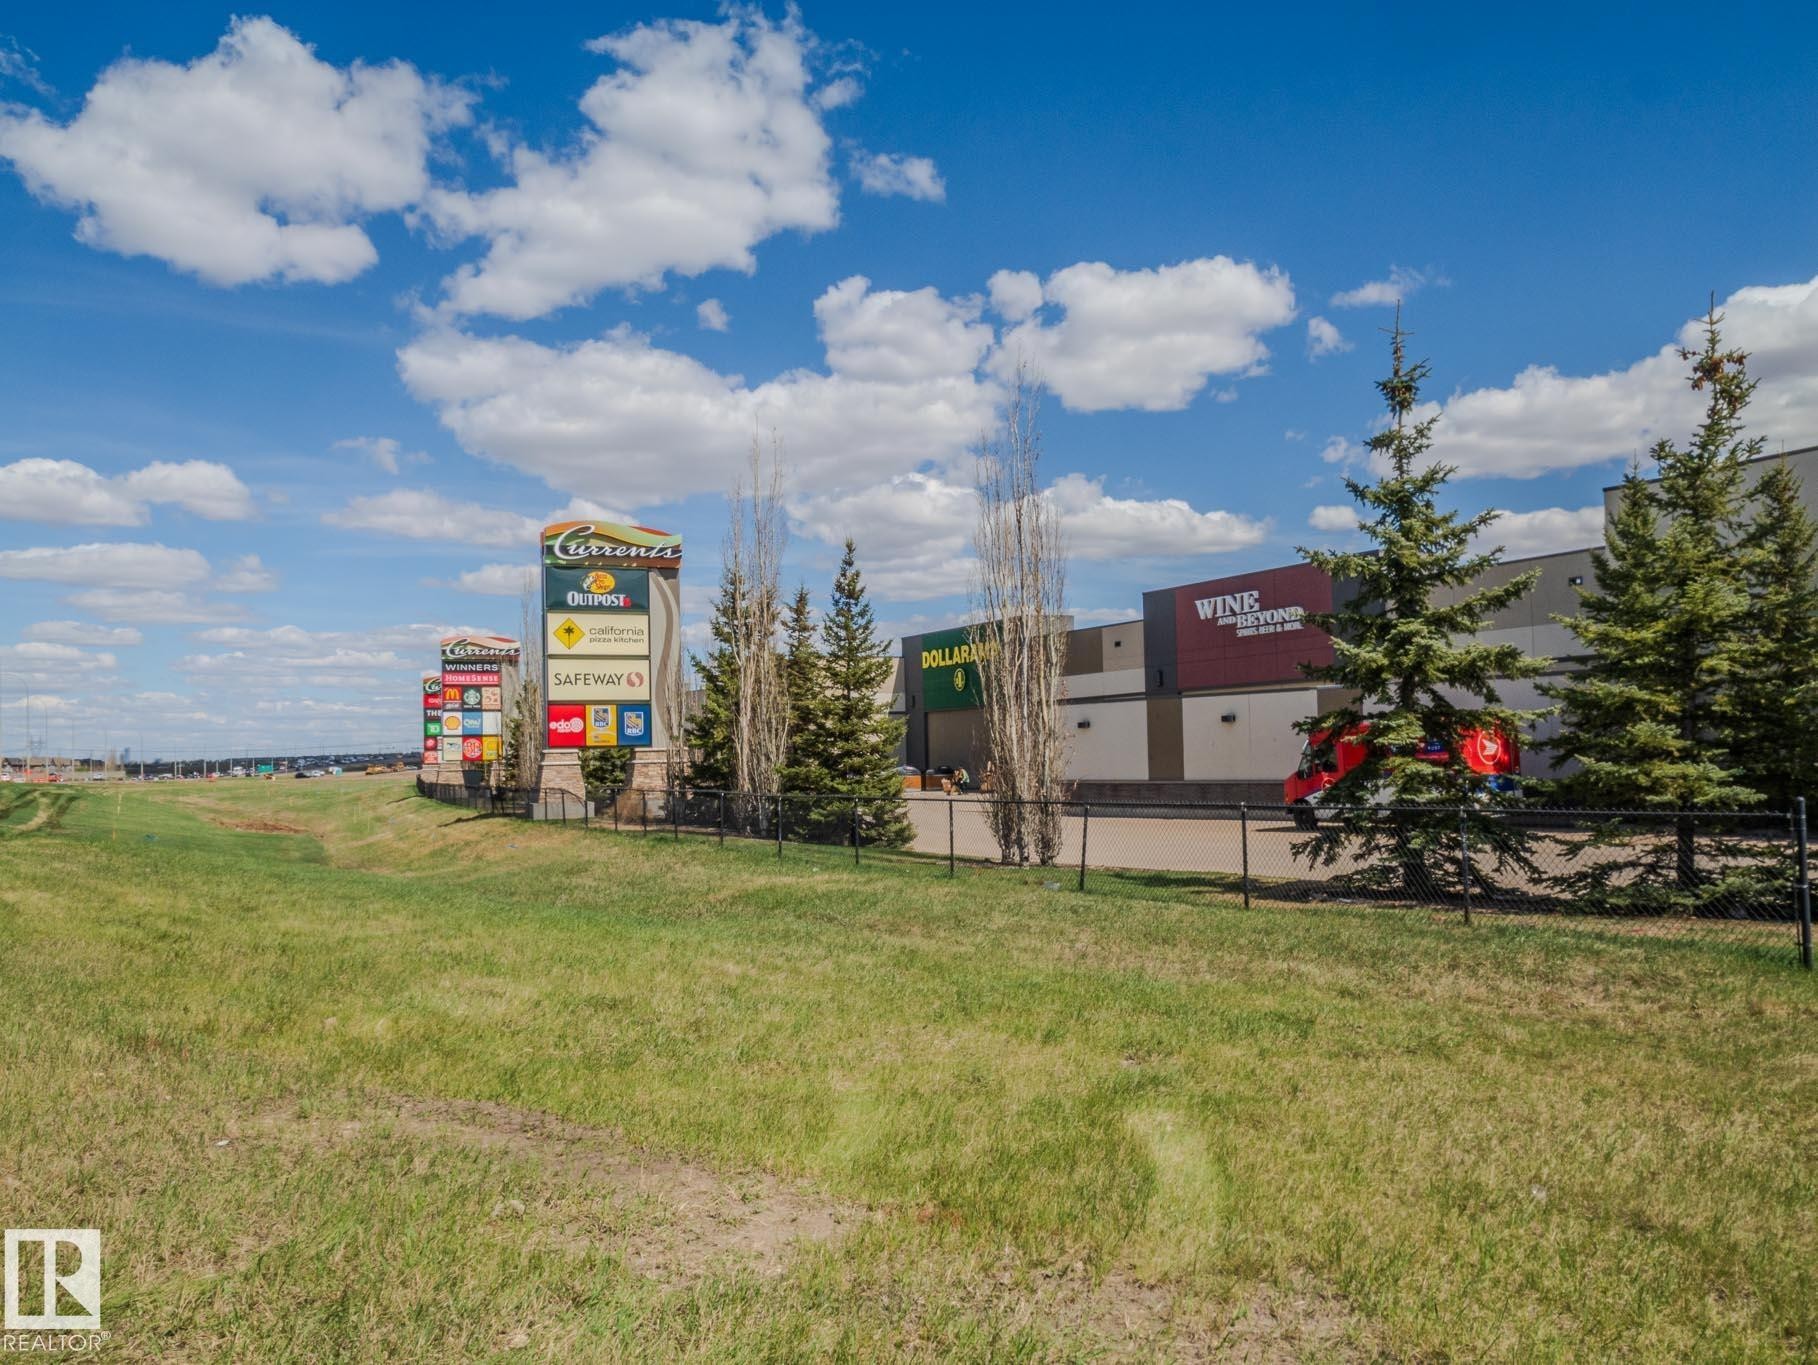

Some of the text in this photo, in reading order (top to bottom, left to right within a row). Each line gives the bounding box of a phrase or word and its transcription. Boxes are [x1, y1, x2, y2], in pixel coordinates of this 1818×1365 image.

[554, 524, 682, 559] Currents
[567, 591, 627, 607] OUTPOST
[1194, 590, 1260, 620] WINE
[1217, 606, 1305, 629] AND BEYOND
[589, 625, 645, 636] california
[589, 636, 645, 644] pizza kitchen
[446, 638, 520, 658] Currents
[445, 663, 499, 672] WINNERS
[554, 672, 624, 686] SAFEWAY
[549, 718, 571, 730] edo
